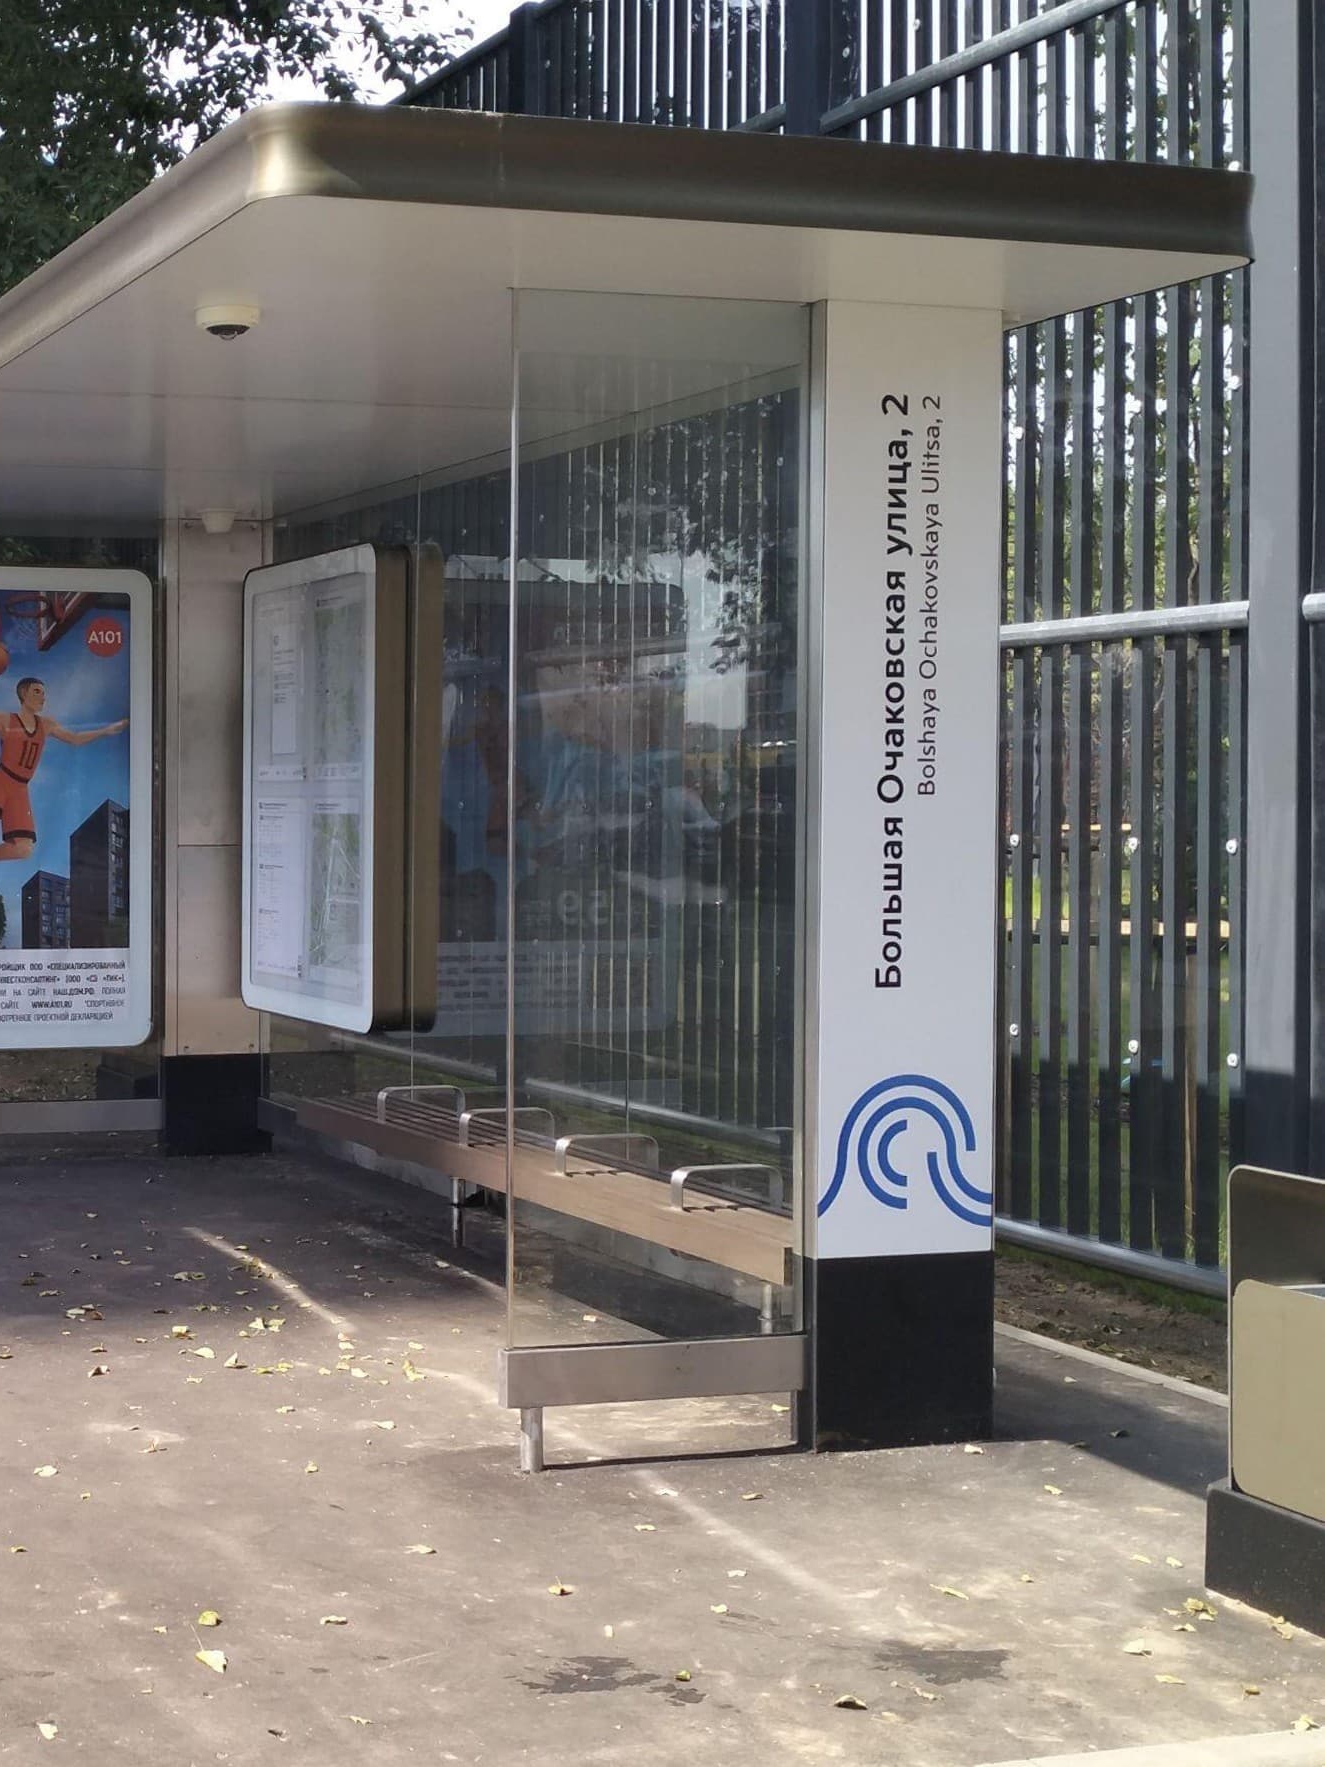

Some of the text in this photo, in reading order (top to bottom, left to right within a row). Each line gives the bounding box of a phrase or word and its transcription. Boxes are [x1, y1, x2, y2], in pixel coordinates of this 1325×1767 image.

[875, 392, 914, 989] Большая Очаковская улица, 2
[917, 394, 944, 797] Bolshaya Ochakovskaya Ulitsa, 2
